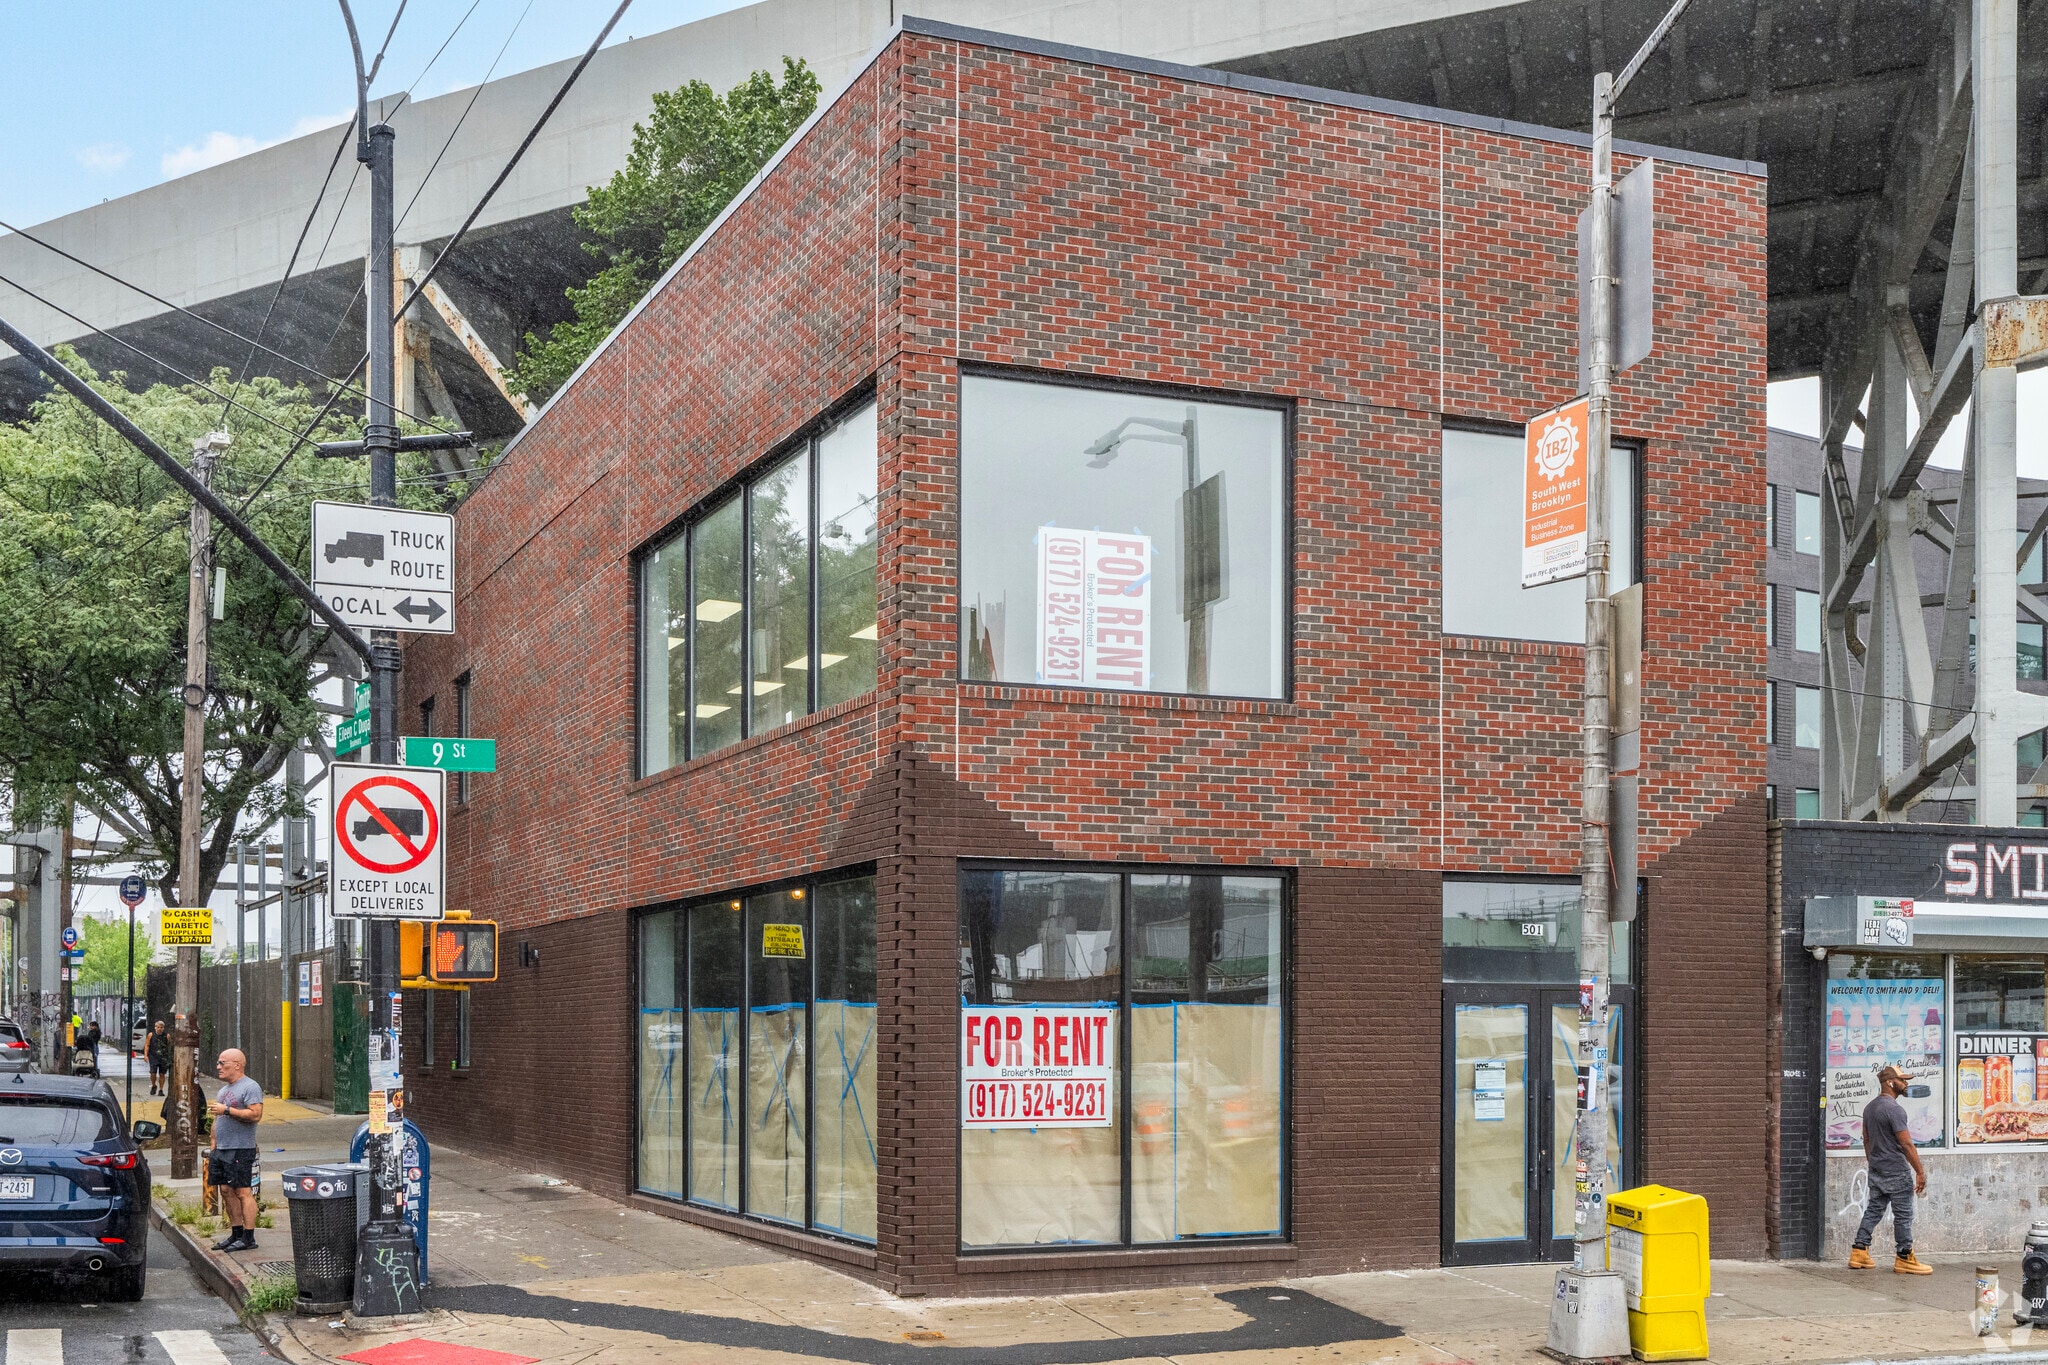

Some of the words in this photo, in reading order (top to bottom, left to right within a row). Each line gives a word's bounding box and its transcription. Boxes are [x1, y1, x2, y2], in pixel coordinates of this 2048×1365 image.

[1546, 437, 1568, 459] IBZ
[1531, 485, 1557, 500] South
[1558, 477, 1581, 492] West
[1531, 493, 1571, 512] Brooklyn
[1530, 528, 1558, 542] Business
[1559, 523, 1575, 534] Zone
[1531, 518, 1558, 532] Industrial
[390, 530, 445, 551] TRUCK
[390, 560, 445, 580] ROUTE
[1048, 538, 1081, 587] (917)
[1096, 538, 1144, 597] FOR
[1086, 573, 1095, 606] Broker's
[319, 595, 387, 616] OCAL
[1047, 592, 1081, 681] 524-9231
[1086, 608, 1095, 648] Protected
[1096, 606, 1143, 687] RENT
[358, 718, 371, 737] Duga
[432, 742, 444, 766] 9
[452, 742, 466, 758] St
[1944, 842, 2048, 899] SMI
[340, 879, 389, 893] EXCEPT
[395, 881, 435, 895] LOCAL
[351, 896, 424, 911] DELIVERIES
[174, 910, 200, 918] CASH
[1523, 924, 1542, 935] 501
[1864, 928, 1880, 937] GOT
[1831, 986, 1863, 995] WELCOME
[1865, 986, 1874, 995] TO
[1875, 986, 1897, 995] SMITH
[1898, 986, 1913, 994] AND
[1922, 986, 1940, 994] DELI!
[966, 1015, 1023, 1068] FOR
[1033, 1016, 1108, 1067] RENT
[1959, 1037, 2032, 1054] DINNER
[1001, 1068, 1034, 1078] Broker's
[1035, 1068, 1073, 1077] Protected
[1835, 1071, 1862, 1082] Delicious
[1834, 1080, 1865, 1090] sandwiches
[969, 1083, 1016, 1118] (917)
[1022, 1082, 1105, 1117] 524-9231
[1830, 1092, 1846, 1100] made
[10, 1182, 30, 1194] 2431
